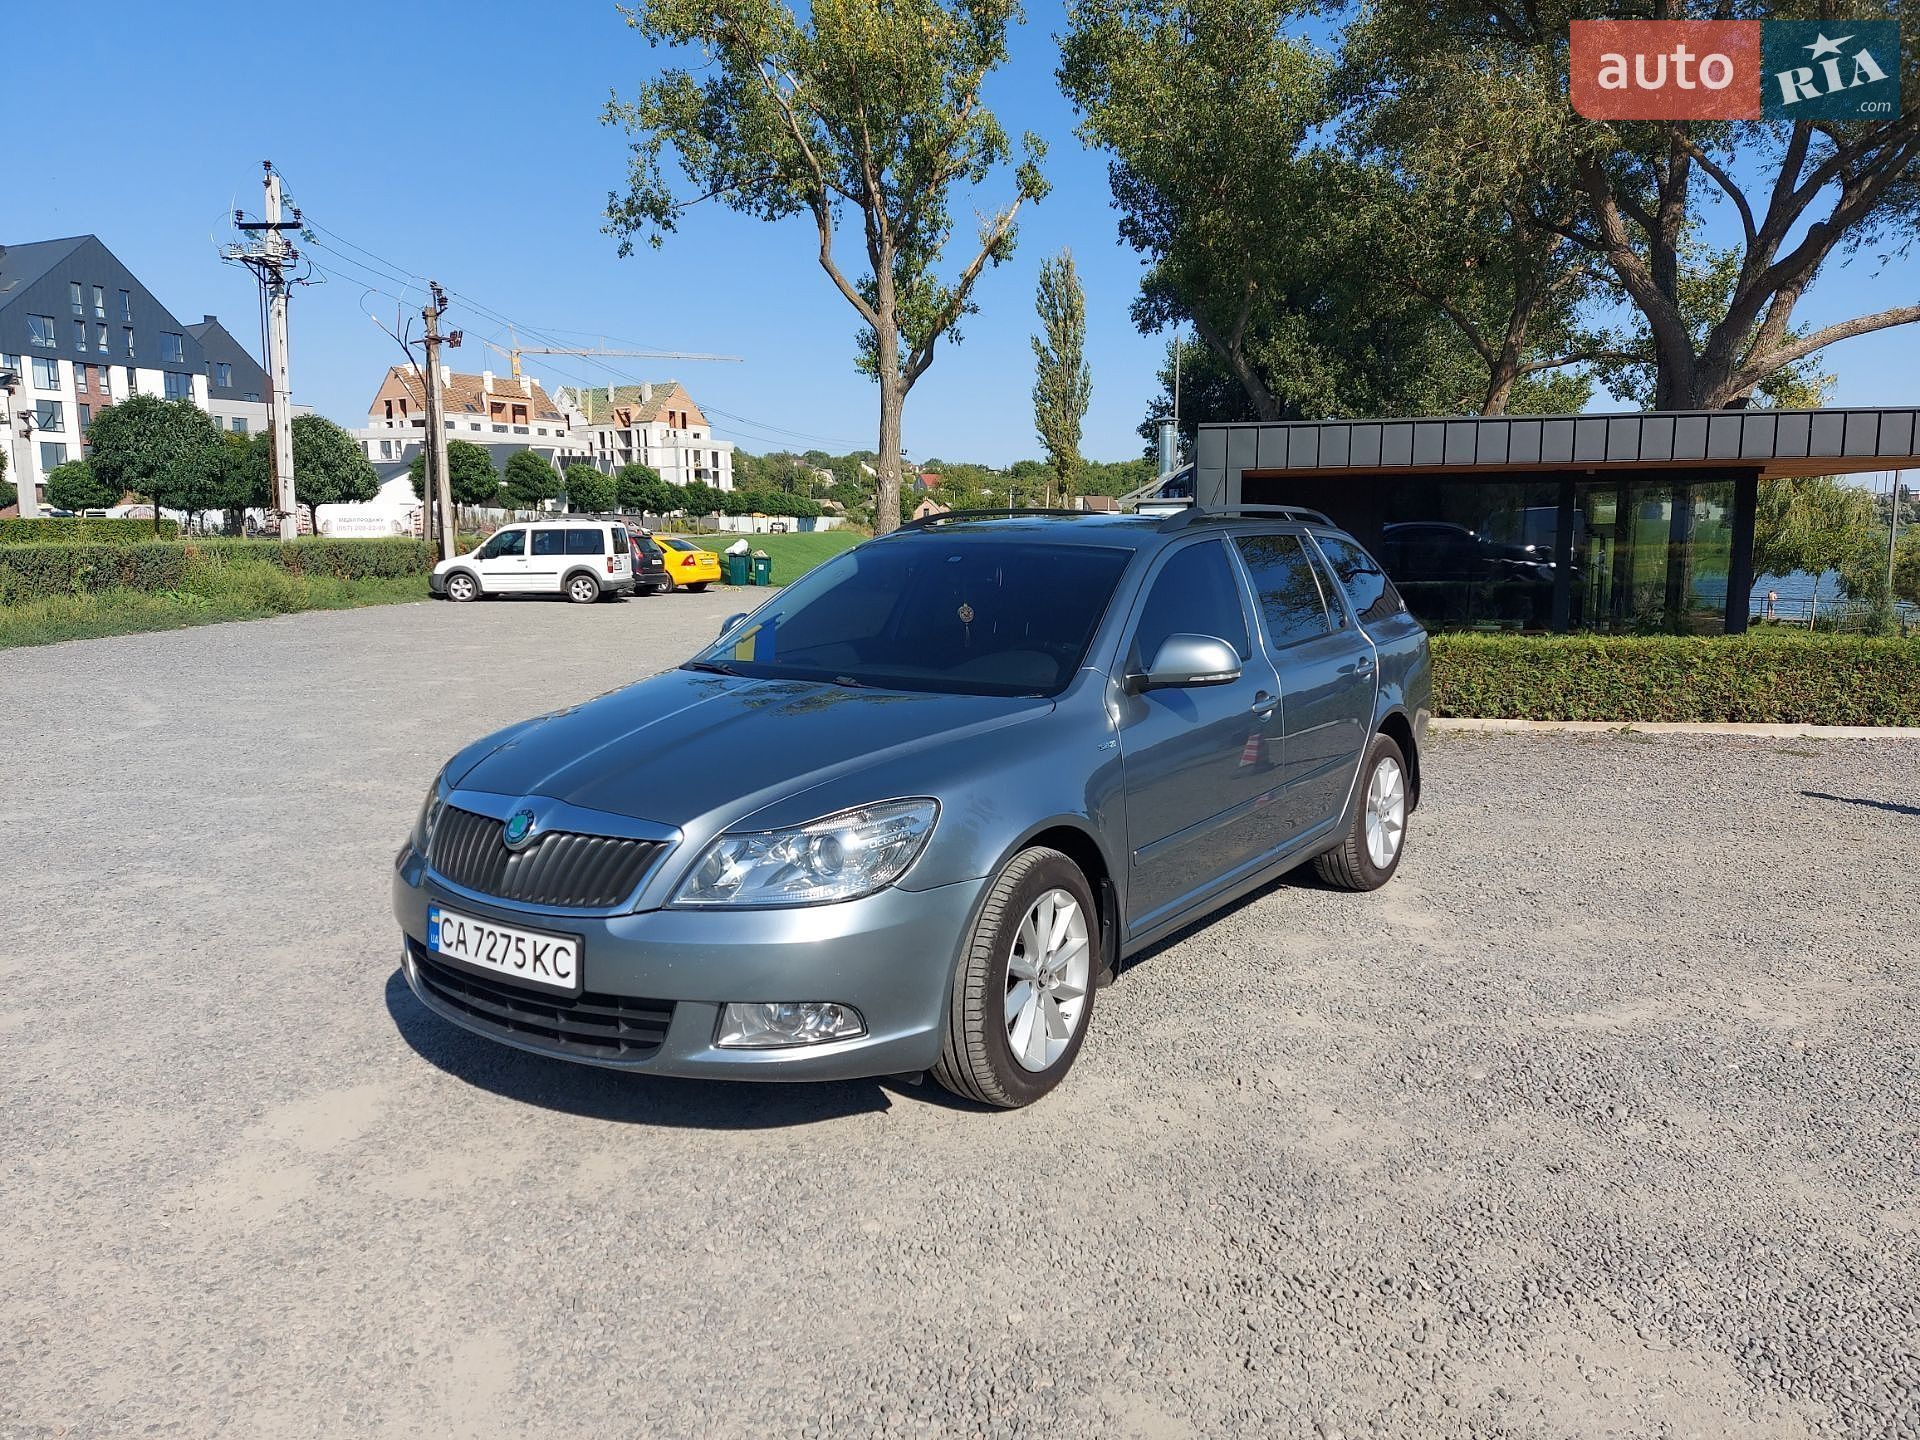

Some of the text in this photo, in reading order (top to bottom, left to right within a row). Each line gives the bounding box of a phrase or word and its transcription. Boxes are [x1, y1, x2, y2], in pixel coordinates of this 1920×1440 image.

[430, 934, 439, 945] UA
[441, 917, 571, 978] CA 7275 KC
